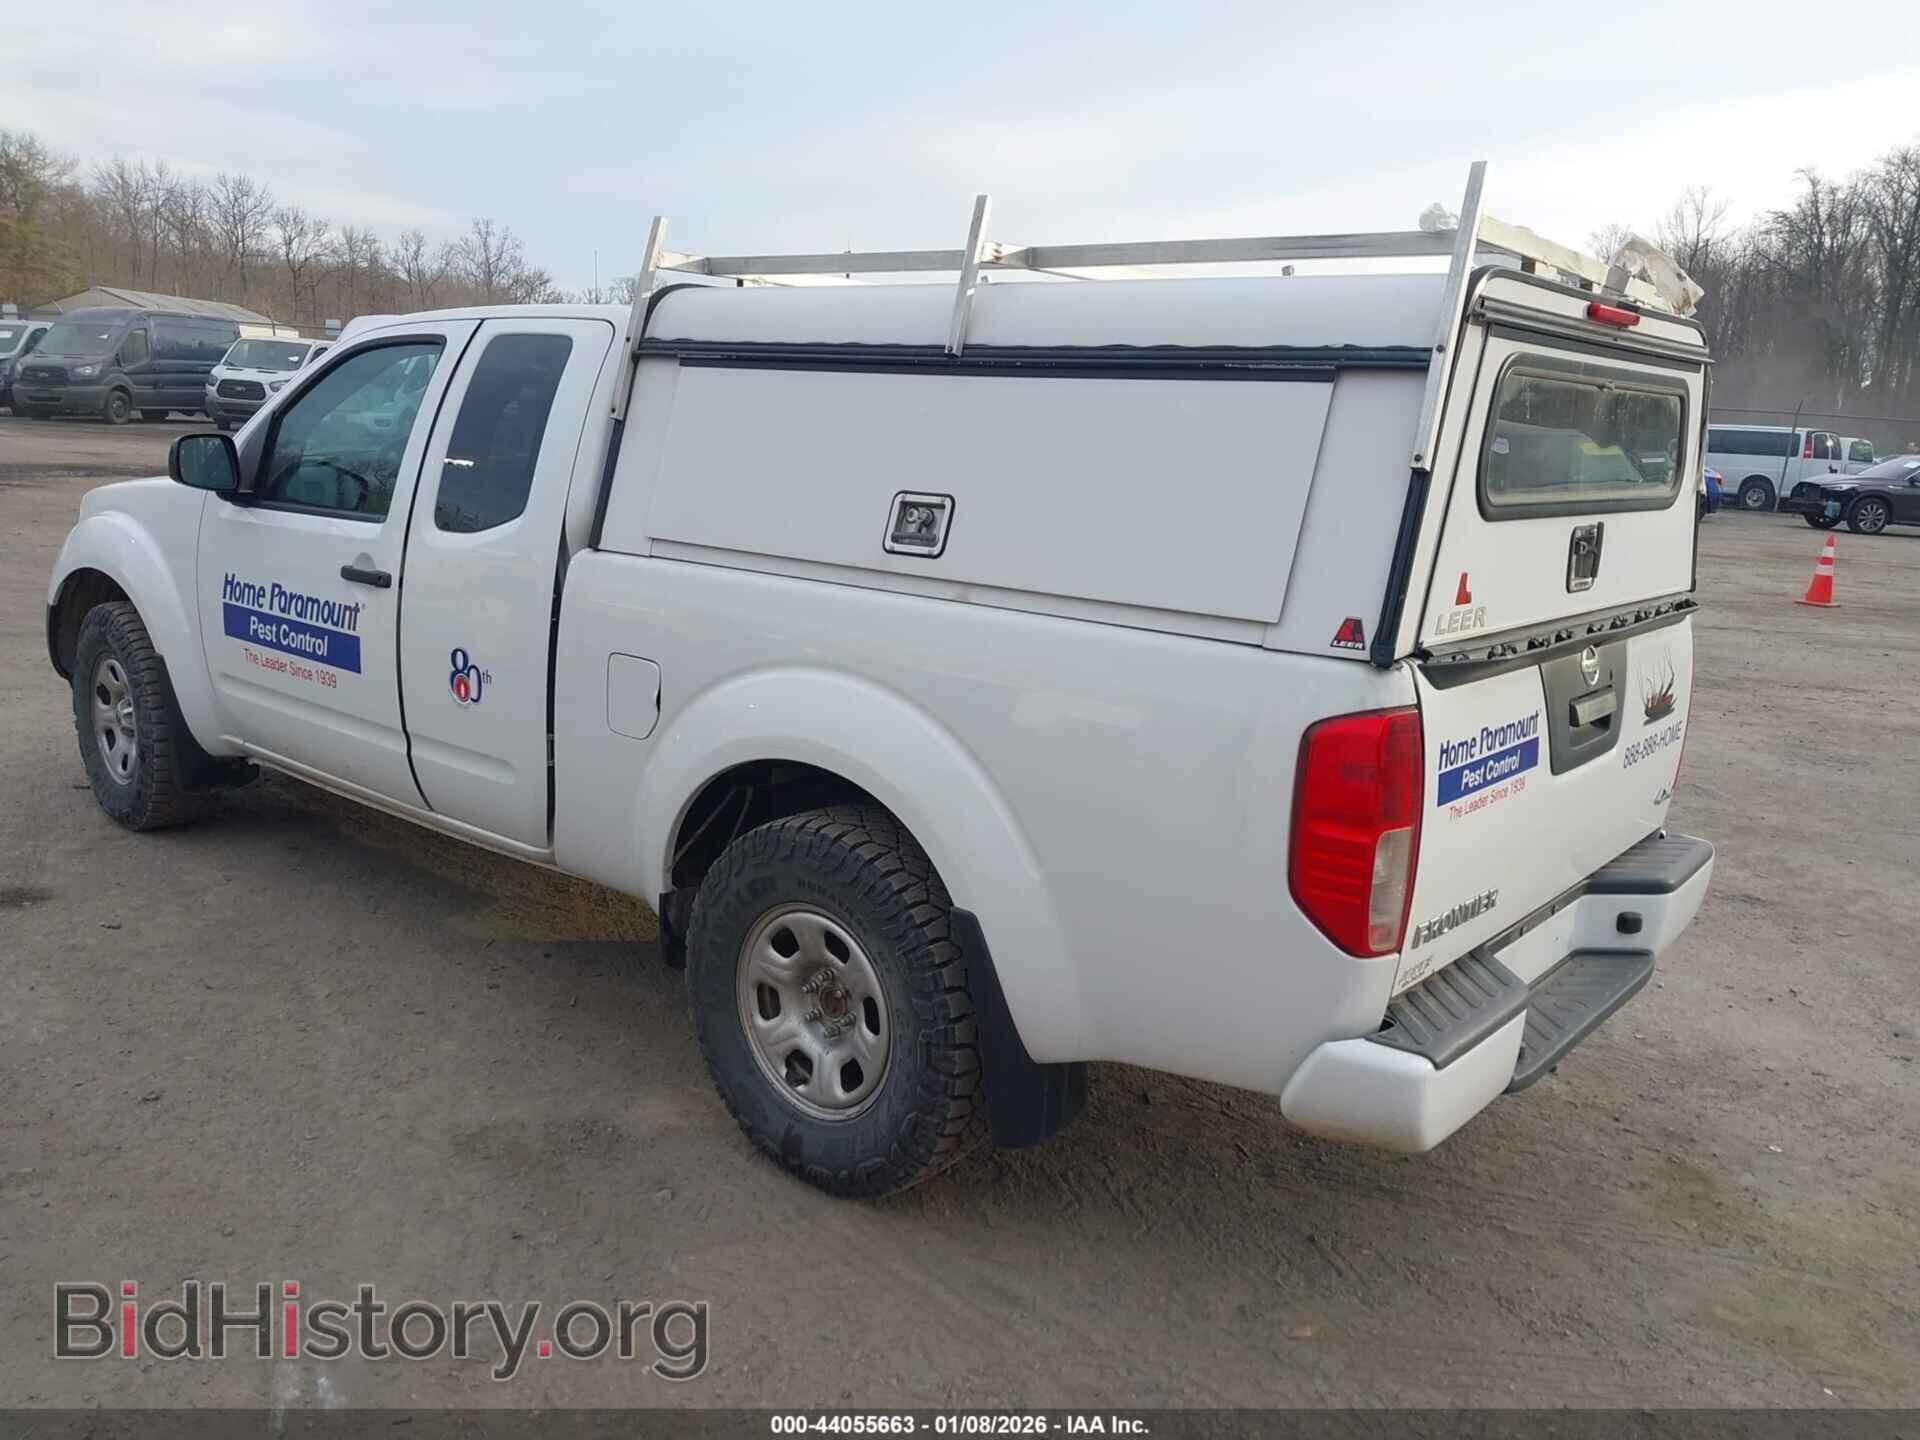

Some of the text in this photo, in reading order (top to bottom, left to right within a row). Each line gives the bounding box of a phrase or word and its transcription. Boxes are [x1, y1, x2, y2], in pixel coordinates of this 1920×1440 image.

[223, 572, 360, 631] Home Paramount
[1435, 607, 1488, 635] LEER
[250, 616, 328, 656] Pest Control
[1332, 639, 1364, 649] LEER
[243, 648, 337, 688] The Leader Since 1939
[1439, 710, 1539, 772] Home Paramount
[1461, 749, 1520, 791] Pest Control
